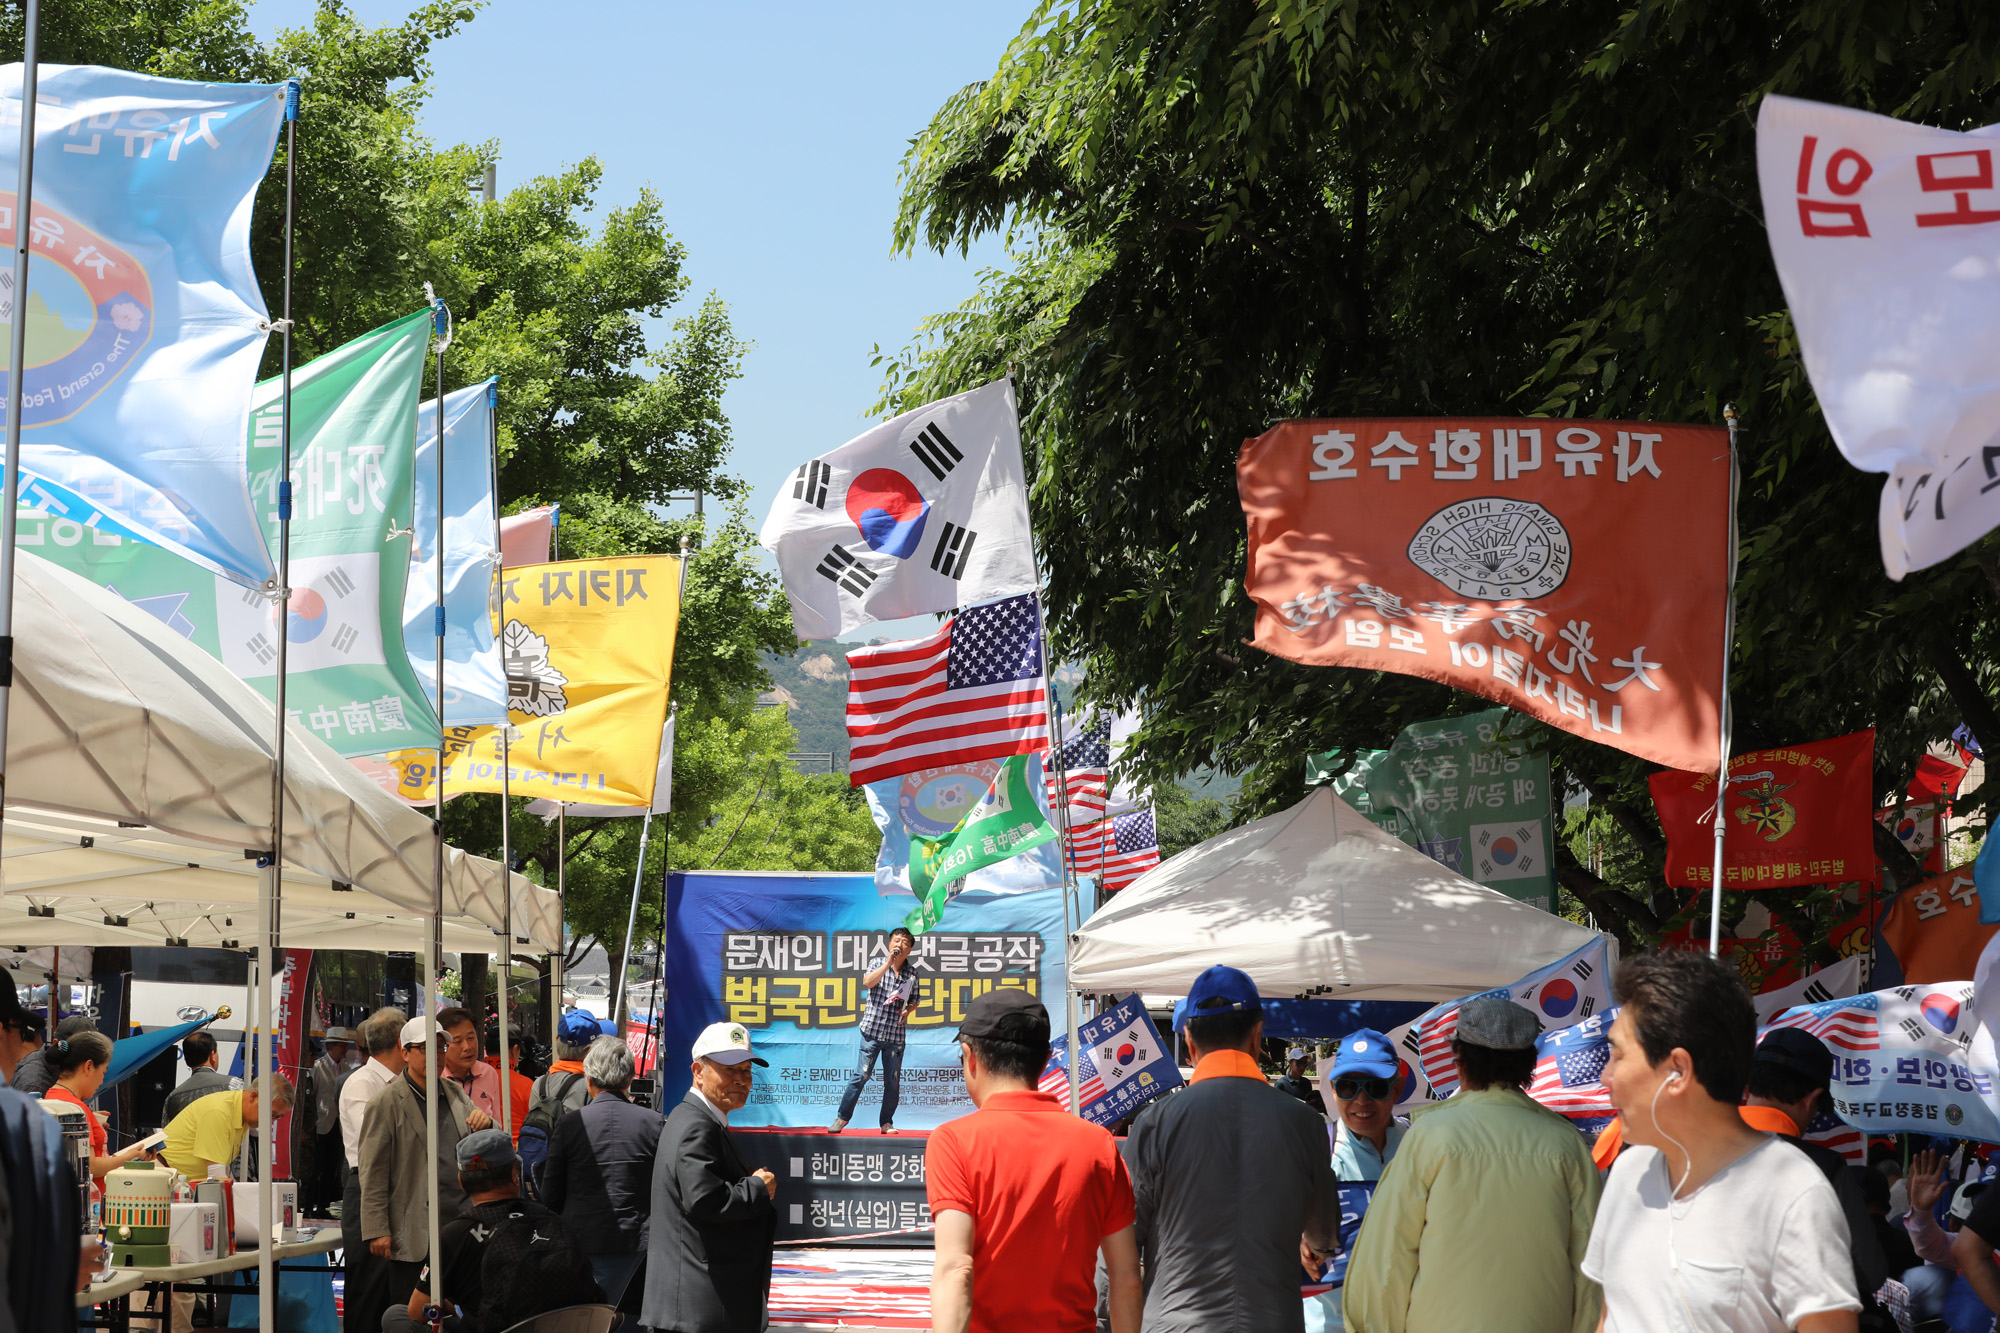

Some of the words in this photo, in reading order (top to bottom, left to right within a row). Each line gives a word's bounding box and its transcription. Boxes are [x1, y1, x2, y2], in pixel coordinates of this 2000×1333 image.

[725, 934, 823, 971] 문재인
[780, 1067, 802, 1081] 주관
[809, 1068, 841, 1081] 문재인
[811, 1152, 884, 1182] 한미동맹
[890, 1153, 926, 1183] 강화
